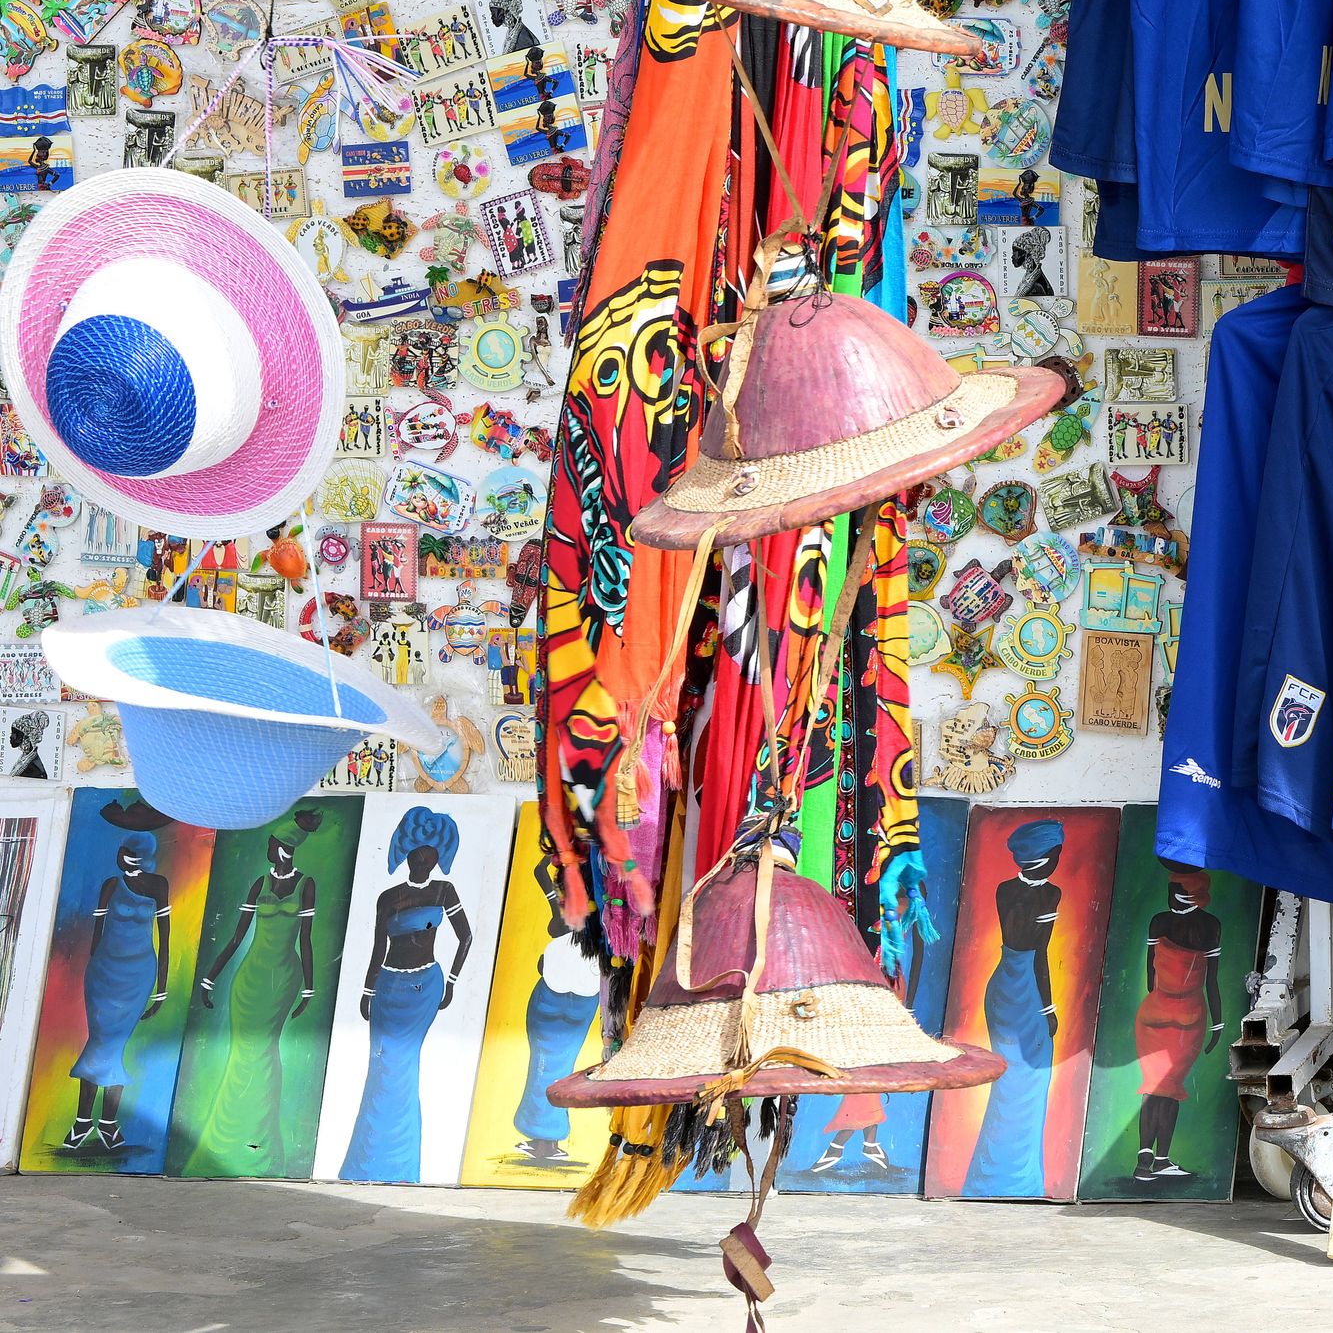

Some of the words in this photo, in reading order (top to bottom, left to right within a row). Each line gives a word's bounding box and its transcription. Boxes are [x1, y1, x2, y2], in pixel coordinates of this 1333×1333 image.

[460, 5, 469, 18] NO
[467, 19, 482, 59] STRESS
[577, 70, 585, 99] VERDE
[477, 72, 486, 85] NO
[482, 87, 496, 127] STRESS
[436, 282, 459, 301] NO
[356, 311, 372, 319] GOA
[401, 292, 420, 301] INDIA
[463, 288, 520, 317] STRESS
[395, 321, 419, 334] CABO
[424, 321, 457, 336] VERDE
[374, 399, 382, 412] NO
[1177, 406, 1186, 422] NO
[1107, 406, 1115, 434] CABO
[374, 414, 382, 455] STRESS
[1177, 425, 1186, 463] STRESS
[1107, 435, 1115, 463] VERDE
[1120, 551, 1134, 559] SAL
[430, 568, 447, 577] NO
[449, 567, 496, 578] STRESS
[1094, 637, 1114, 645] BOA
[1115, 638, 1141, 647] VISTA
[1286, 681, 1319, 701] FCF
[1088, 718, 1109, 726] CABO
[1110, 719, 1138, 729] VERDE
[1015, 747, 1038, 758] CABO
[1039, 739, 1066, 757] VERDE
[1191, 770, 1222, 789] tempo
